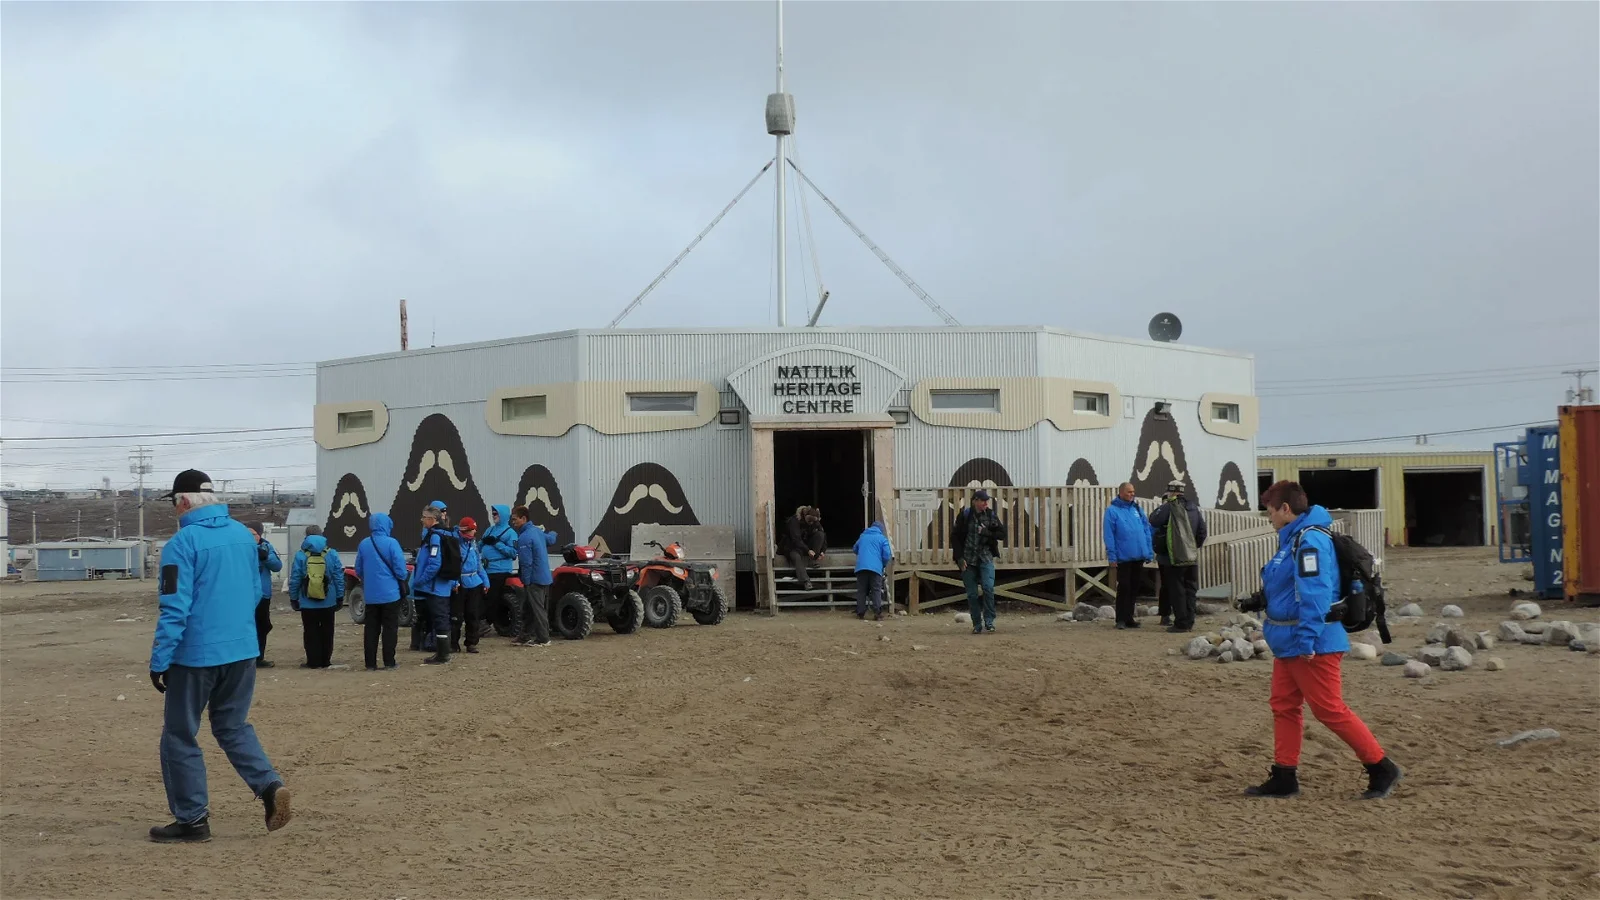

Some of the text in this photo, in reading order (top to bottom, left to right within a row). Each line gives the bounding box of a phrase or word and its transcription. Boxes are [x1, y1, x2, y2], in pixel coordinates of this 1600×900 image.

[778, 365, 856, 379] NATTILIK
[773, 382, 862, 396] HERITAGE
[783, 400, 854, 414] CENTRE
